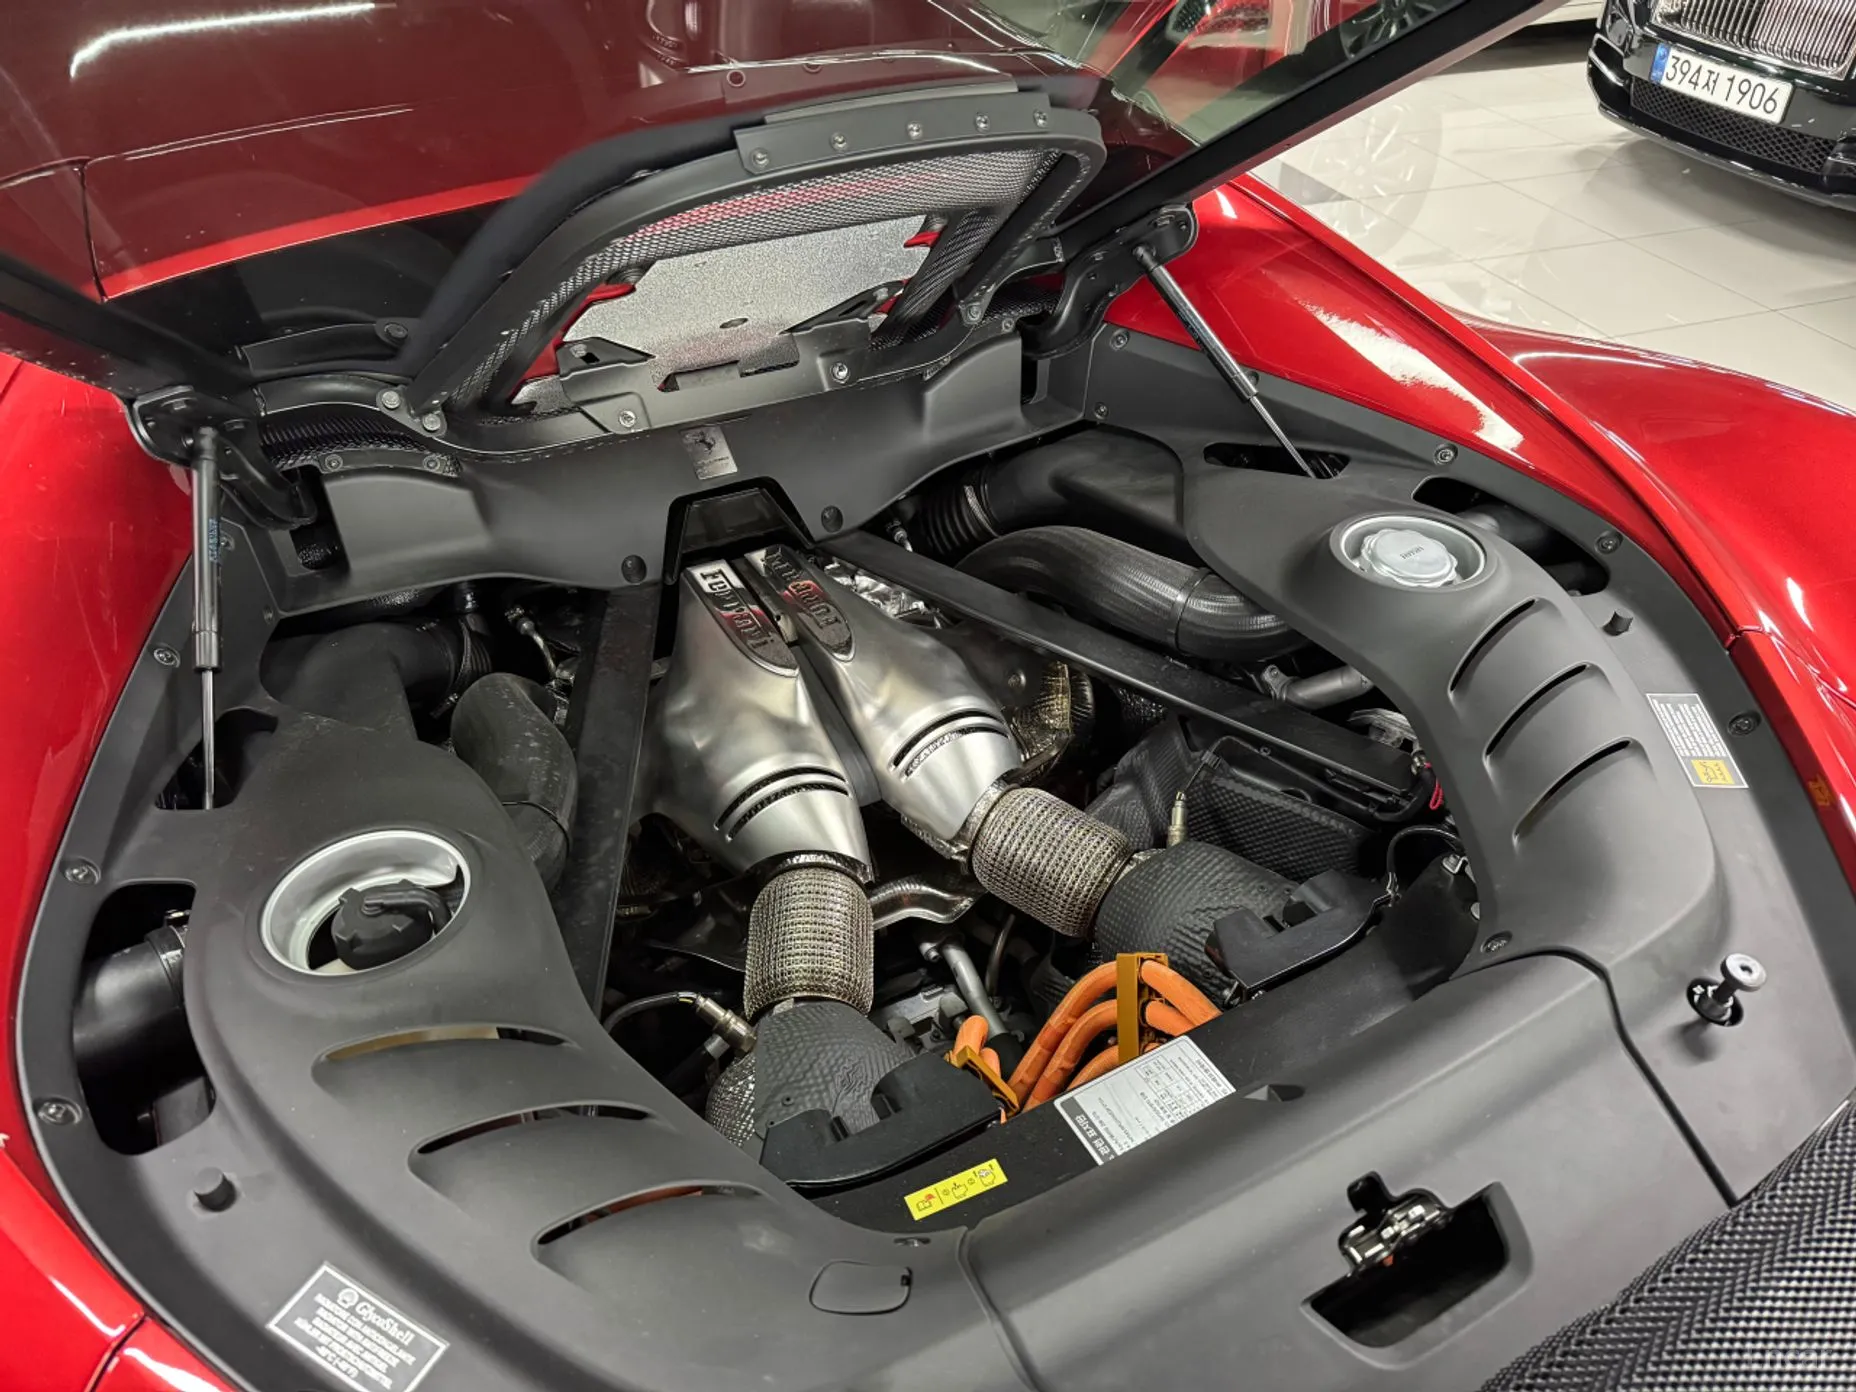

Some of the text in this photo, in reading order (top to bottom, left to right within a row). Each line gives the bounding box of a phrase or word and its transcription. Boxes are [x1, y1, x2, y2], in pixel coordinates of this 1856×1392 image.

[1665, 54, 1779, 115] 394저 1906
[700, 568, 774, 649] Ferrari
